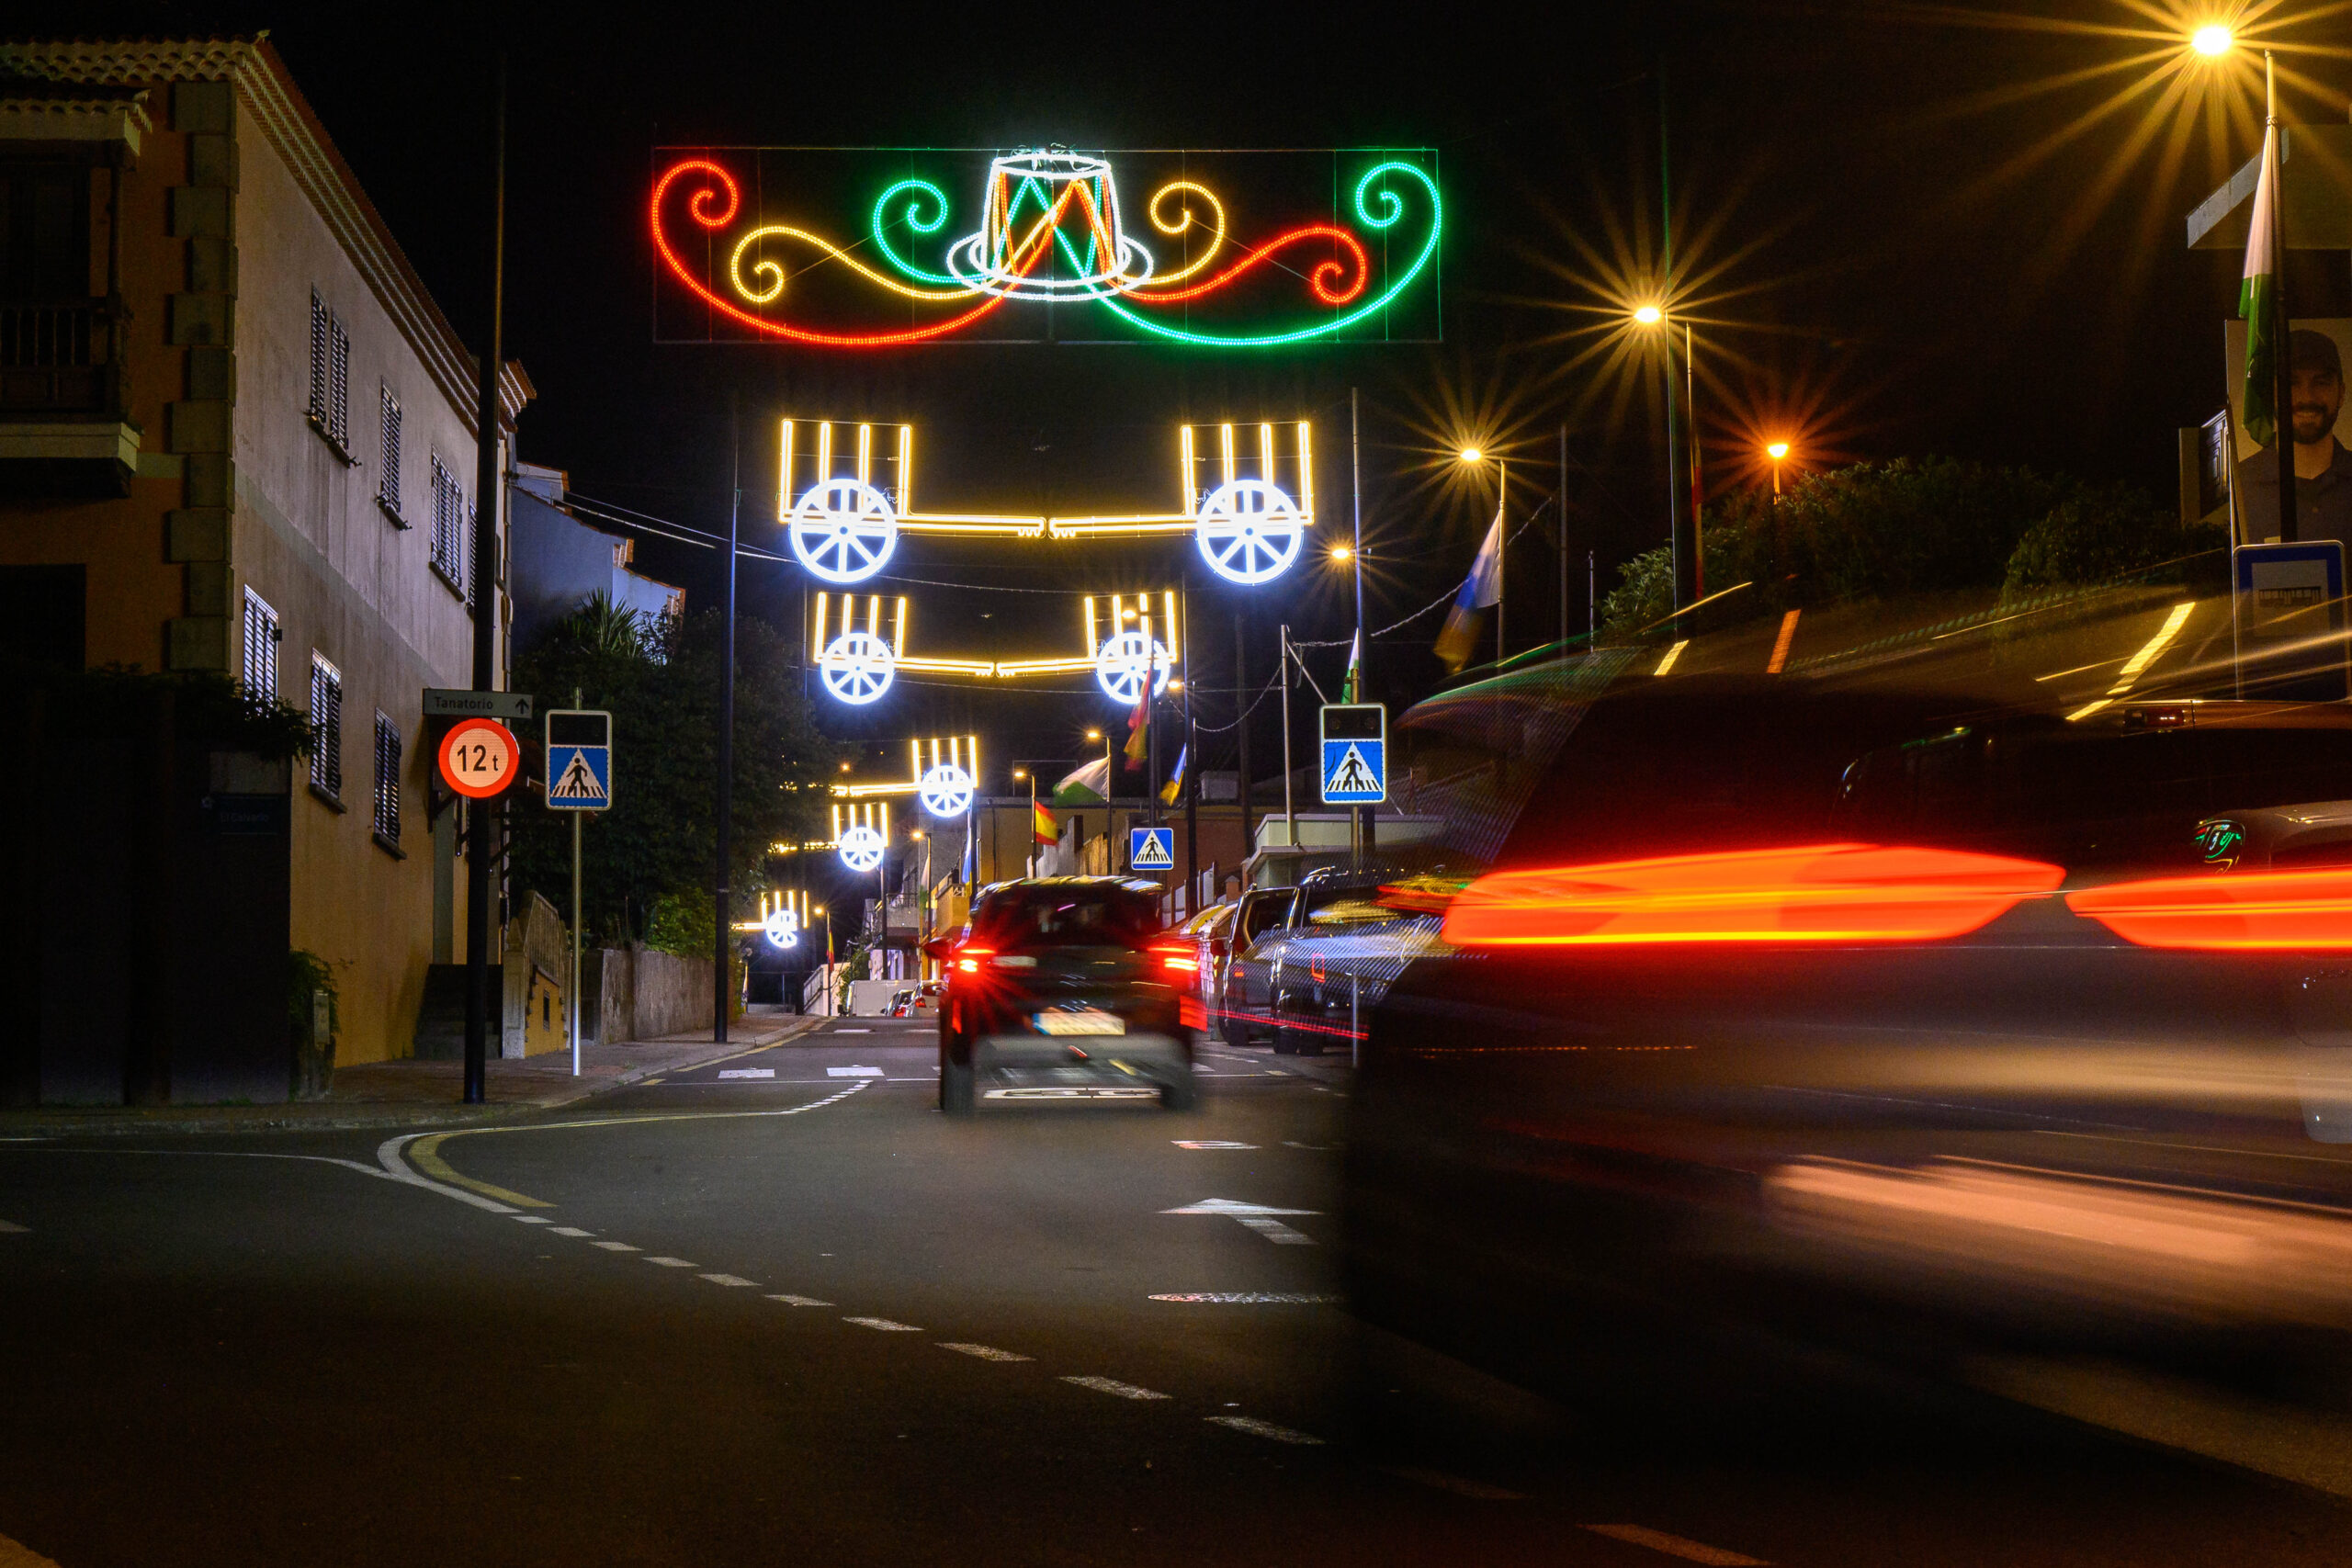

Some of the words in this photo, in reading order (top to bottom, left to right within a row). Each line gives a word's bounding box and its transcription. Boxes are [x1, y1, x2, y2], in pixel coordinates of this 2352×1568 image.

[434, 696, 493, 710] Tanatorio
[457, 744, 487, 773] 12
[492, 754, 499, 772] t
